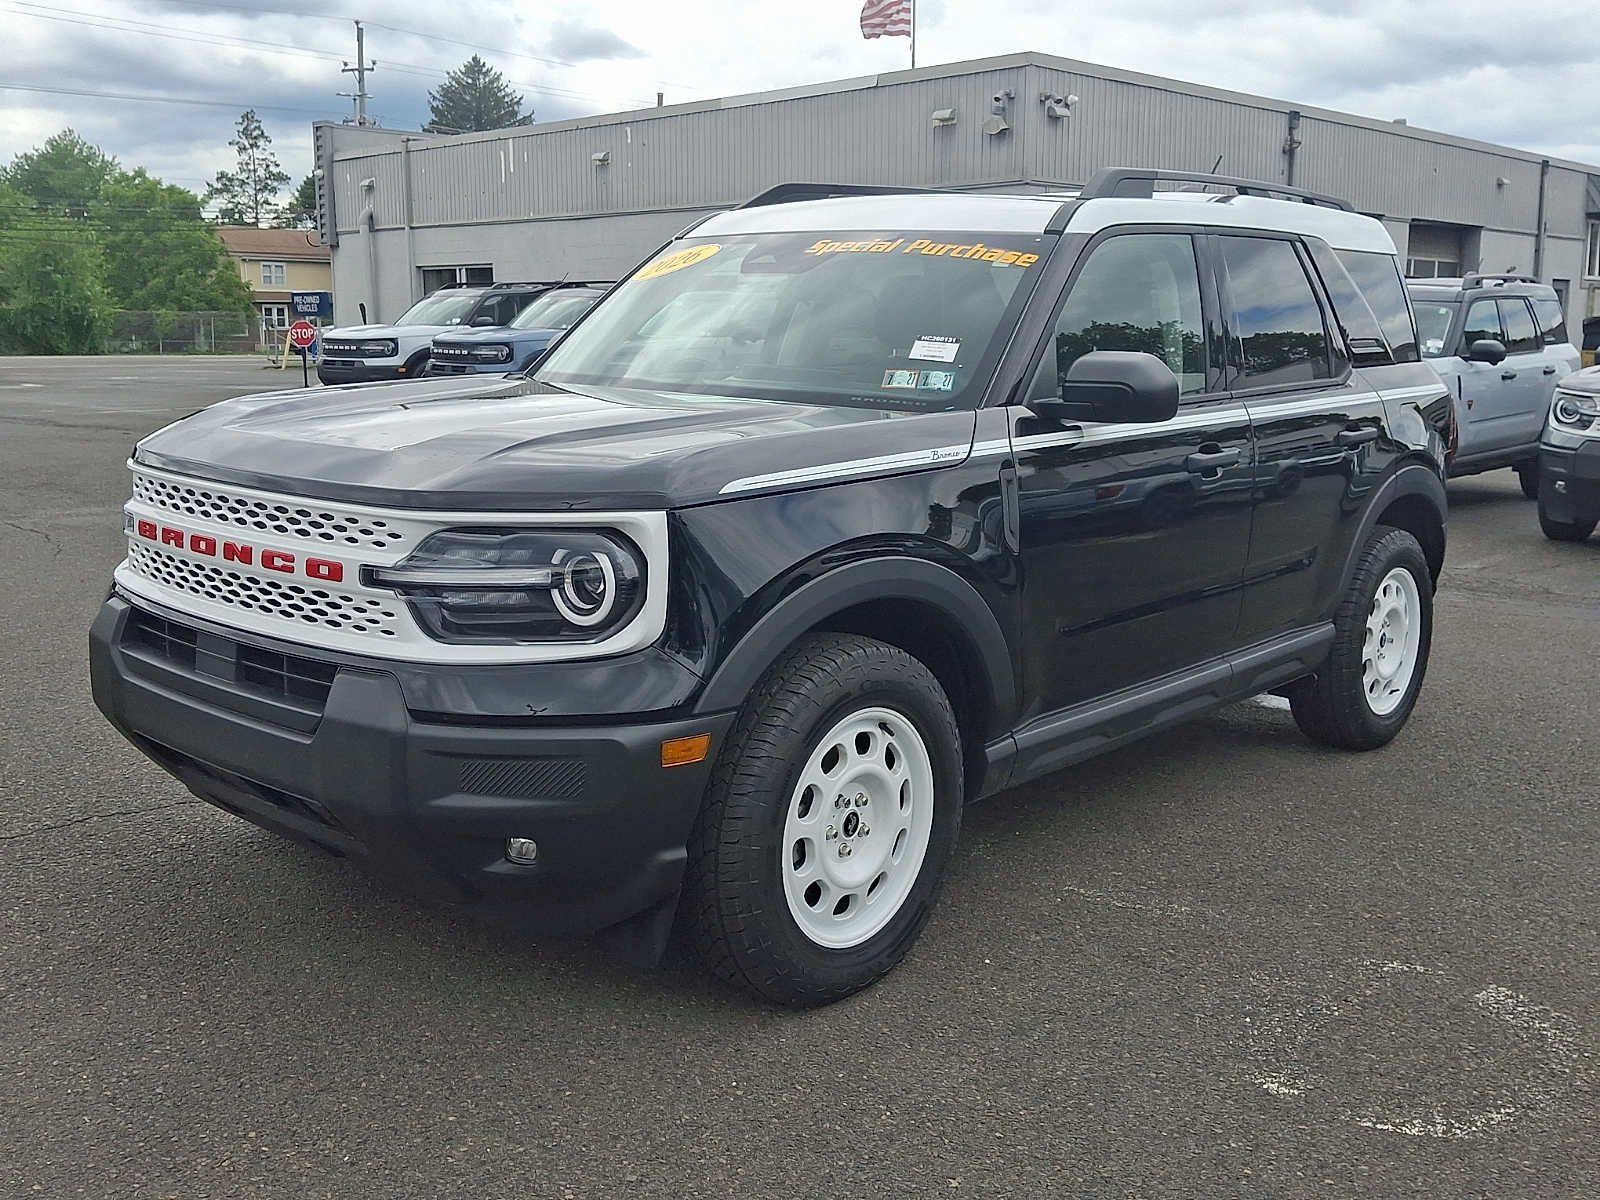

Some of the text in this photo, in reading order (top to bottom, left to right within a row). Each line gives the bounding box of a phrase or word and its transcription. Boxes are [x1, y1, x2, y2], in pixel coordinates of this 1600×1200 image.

[804, 238, 1040, 267] Special Purchase
[293, 295, 320, 304] PRE-OWNED
[296, 303, 319, 312] VEHICLES
[291, 328, 314, 339] STOP
[137, 518, 344, 583] BRONCO
